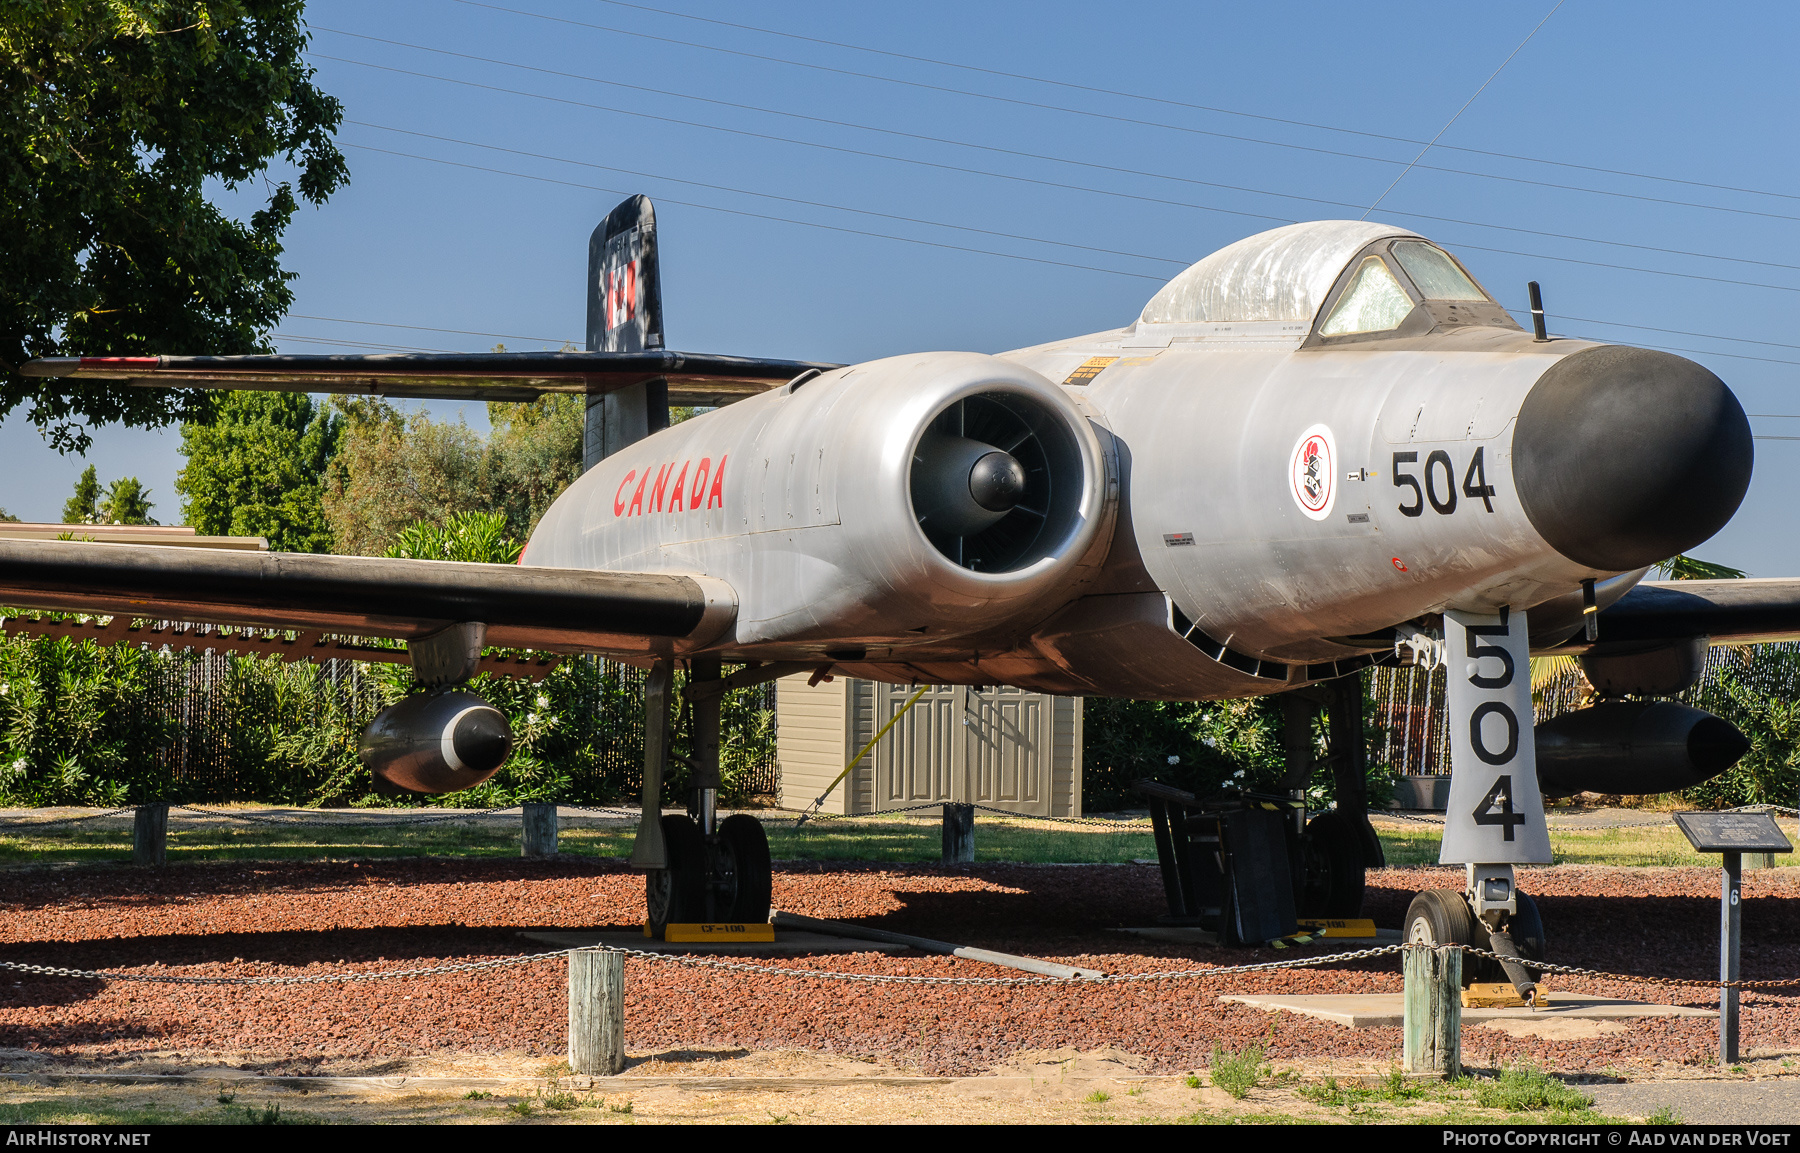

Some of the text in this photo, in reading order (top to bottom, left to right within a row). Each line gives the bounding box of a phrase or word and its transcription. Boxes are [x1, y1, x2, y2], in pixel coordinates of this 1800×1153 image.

[613, 454, 728, 517] CANADA
[1392, 446, 1496, 517] 504
[1465, 625, 1525, 841] 504
[1730, 889, 1739, 905] 6
[701, 925, 745, 933] CF-100
